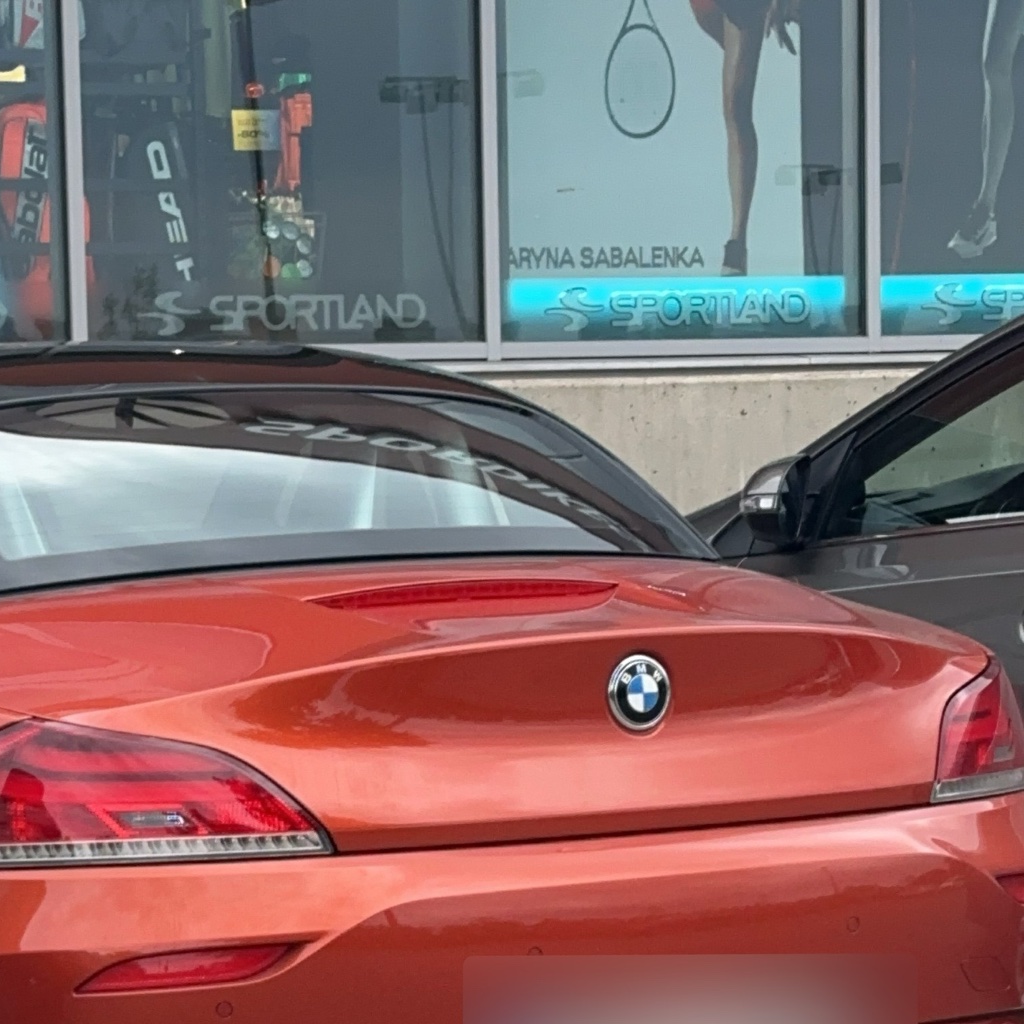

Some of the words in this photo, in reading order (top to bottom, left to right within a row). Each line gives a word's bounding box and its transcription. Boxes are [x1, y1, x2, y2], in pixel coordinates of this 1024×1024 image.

[508, 246, 576, 269] ARYNA
[580, 246, 705, 269] SABALENKA
[209, 293, 427, 331] SPORTLAND
[609, 288, 811, 327] SPORTLAND
[621, 663, 663, 685] BMW
